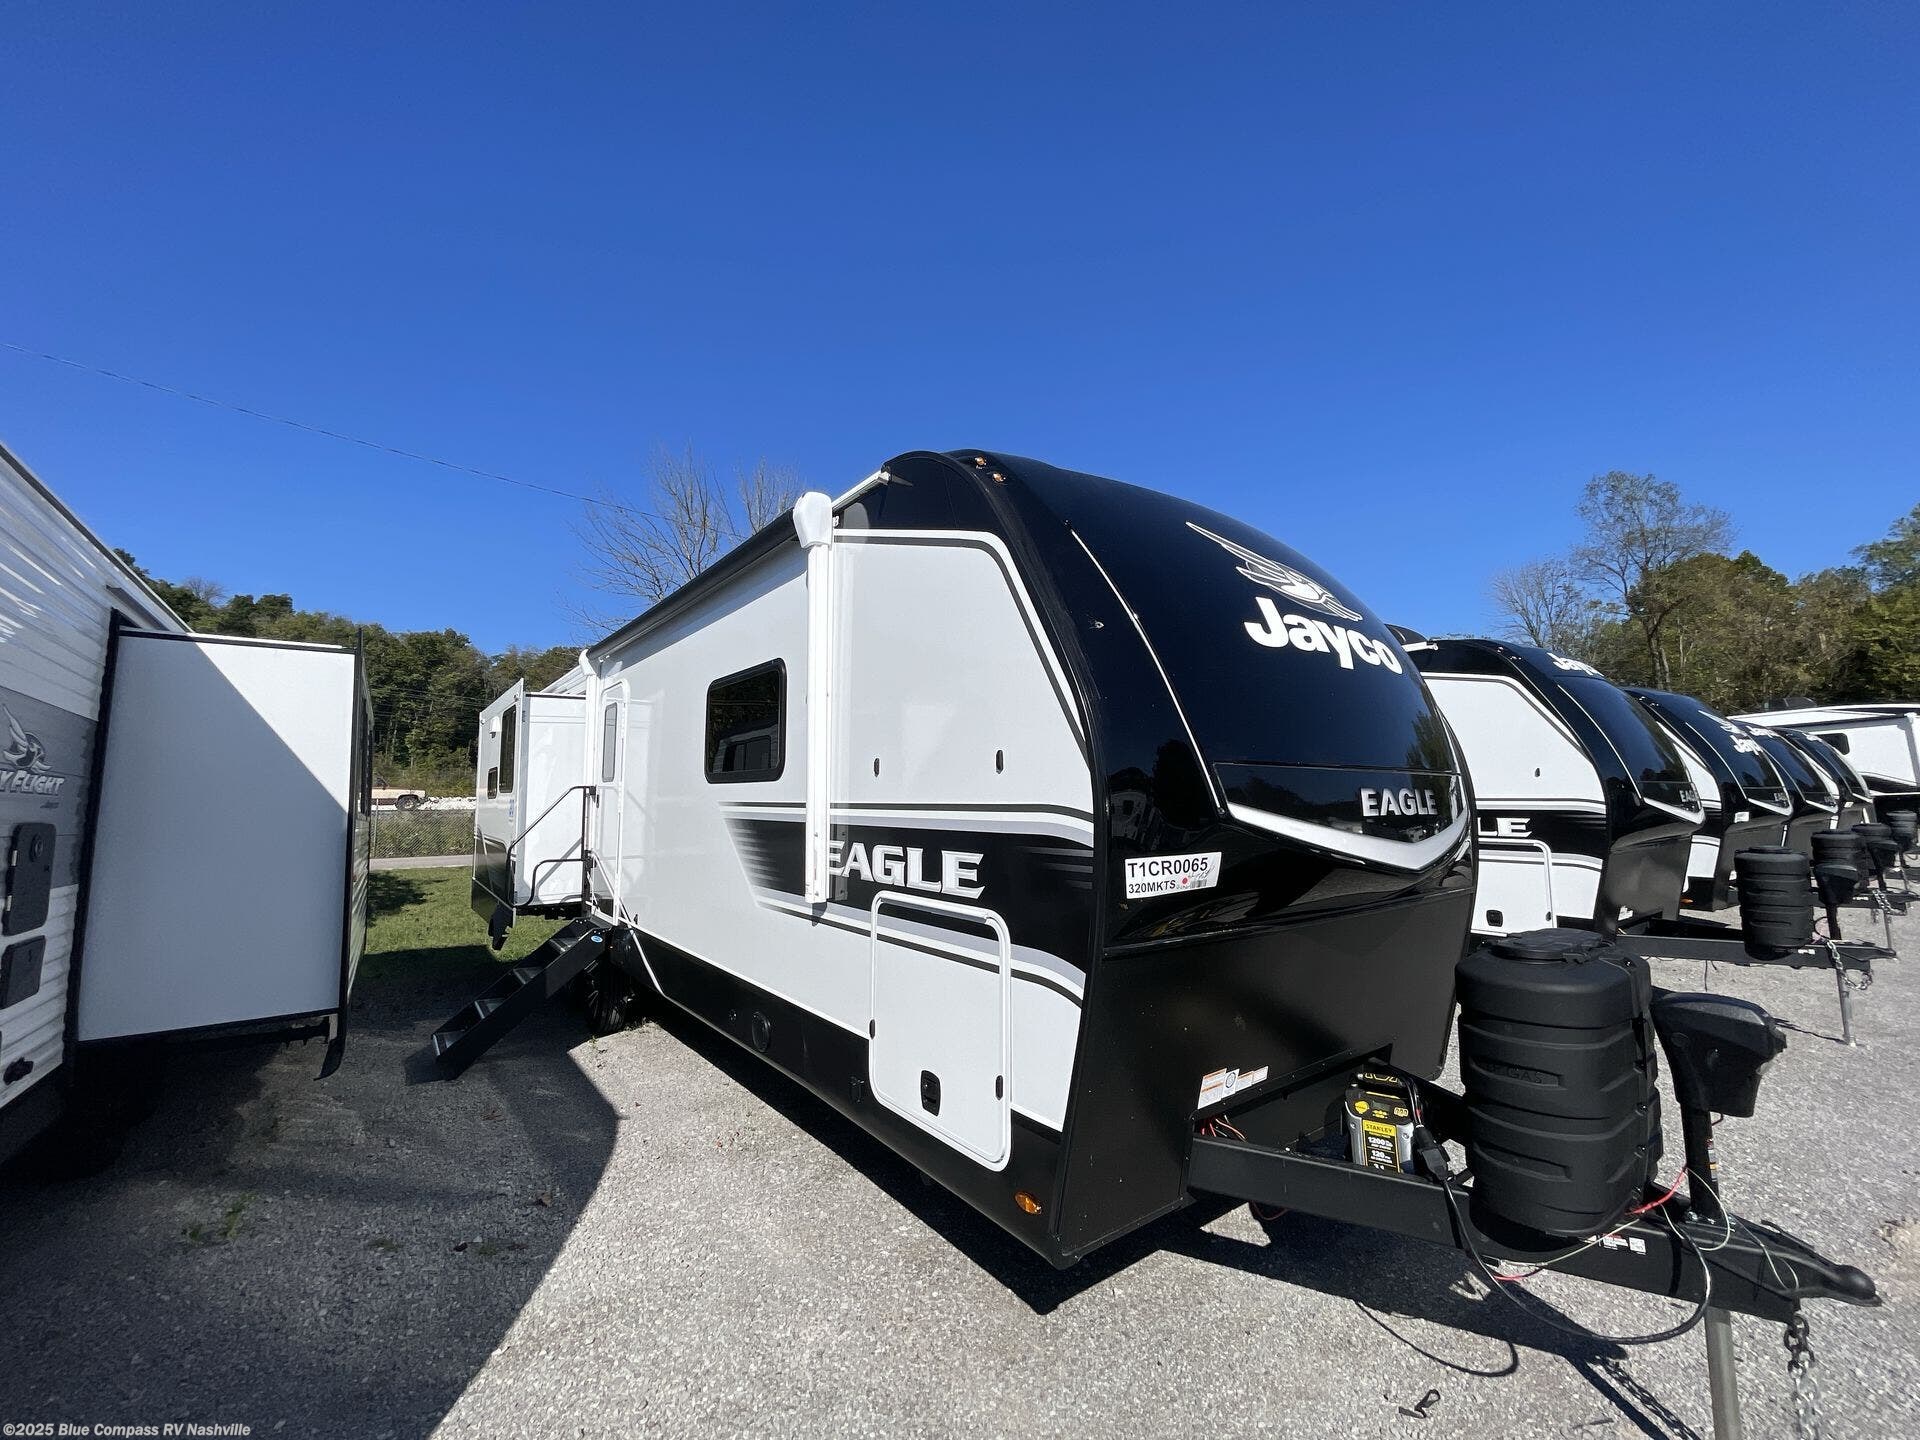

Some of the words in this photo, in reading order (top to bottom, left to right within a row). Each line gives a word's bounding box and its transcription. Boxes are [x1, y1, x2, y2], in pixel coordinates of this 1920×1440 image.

[1243, 596, 1403, 675] Jayco
[10, 769, 65, 796] FLIGHT
[1360, 787, 1438, 817] EAGLE
[1127, 857, 1208, 878] T1CR0065
[1128, 879, 1176, 894] 320MKTS
[1365, 1123, 1393, 1134] STANLEY
